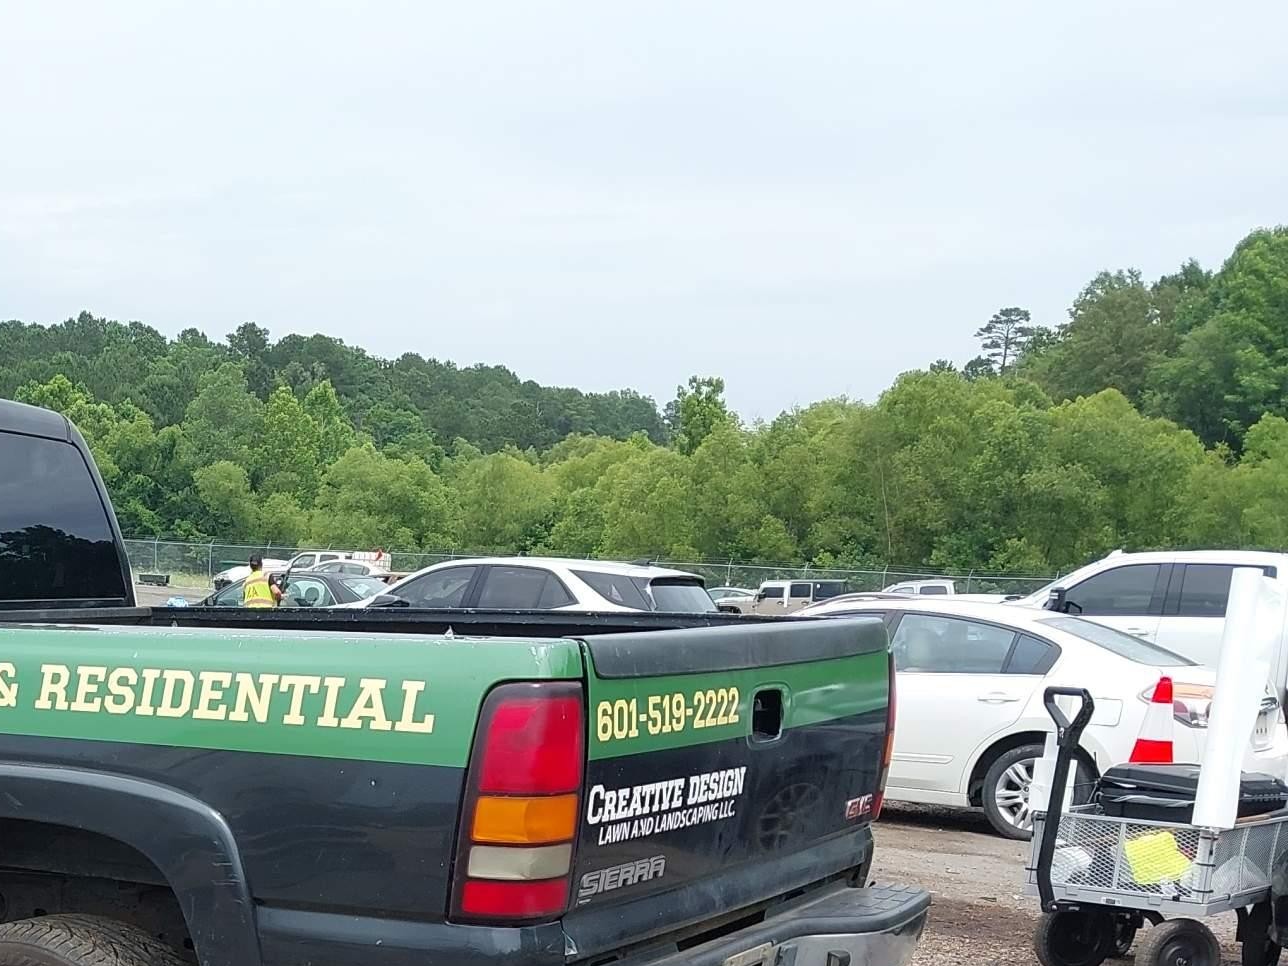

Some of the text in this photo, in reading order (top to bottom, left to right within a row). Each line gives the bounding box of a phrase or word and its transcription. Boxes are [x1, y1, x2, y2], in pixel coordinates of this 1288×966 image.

[34, 664, 435, 734] RESIDENTIAL
[597, 687, 740, 742] 601-519-2222
[587, 766, 746, 825] CREATIVE DESIGN
[598, 799, 736, 846] LAWN AND LANDSCAPING LLC.
[578, 854, 666, 898] SIERRA
